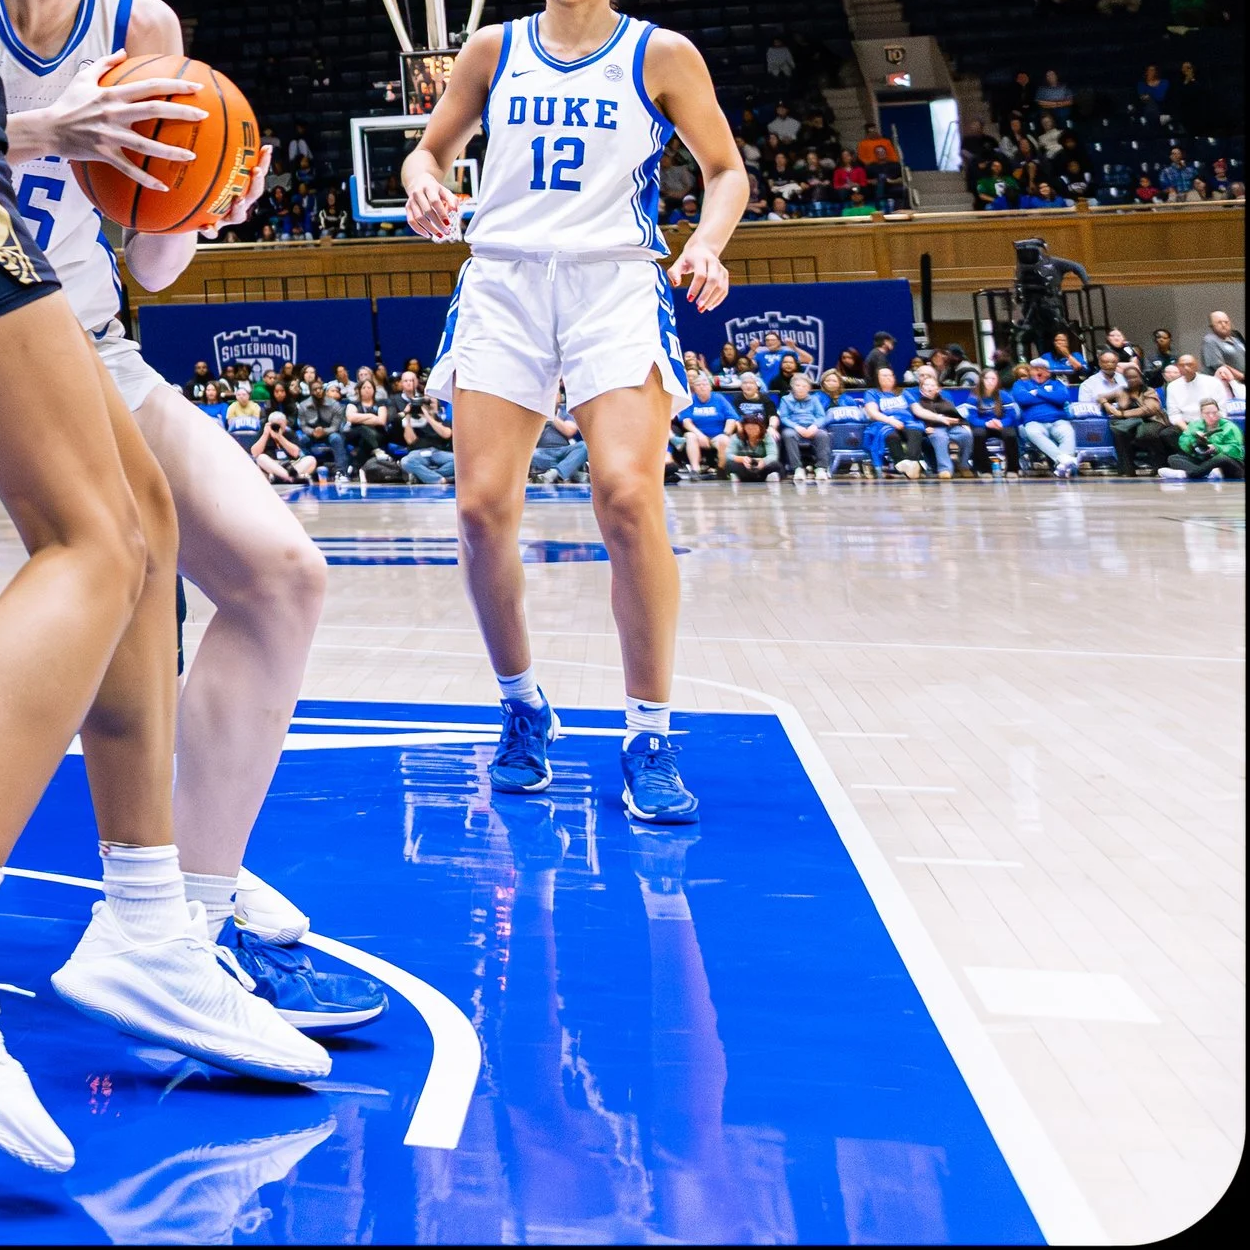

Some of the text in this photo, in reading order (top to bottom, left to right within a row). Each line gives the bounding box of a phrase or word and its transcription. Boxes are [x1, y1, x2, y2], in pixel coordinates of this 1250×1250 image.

[508, 96, 618, 130] DUKE
[530, 136, 585, 192] 12
[16, 174, 66, 252] 5
[221, 343, 290, 362] SISTERHOOD
[735, 329, 817, 350] SISTHOOD
